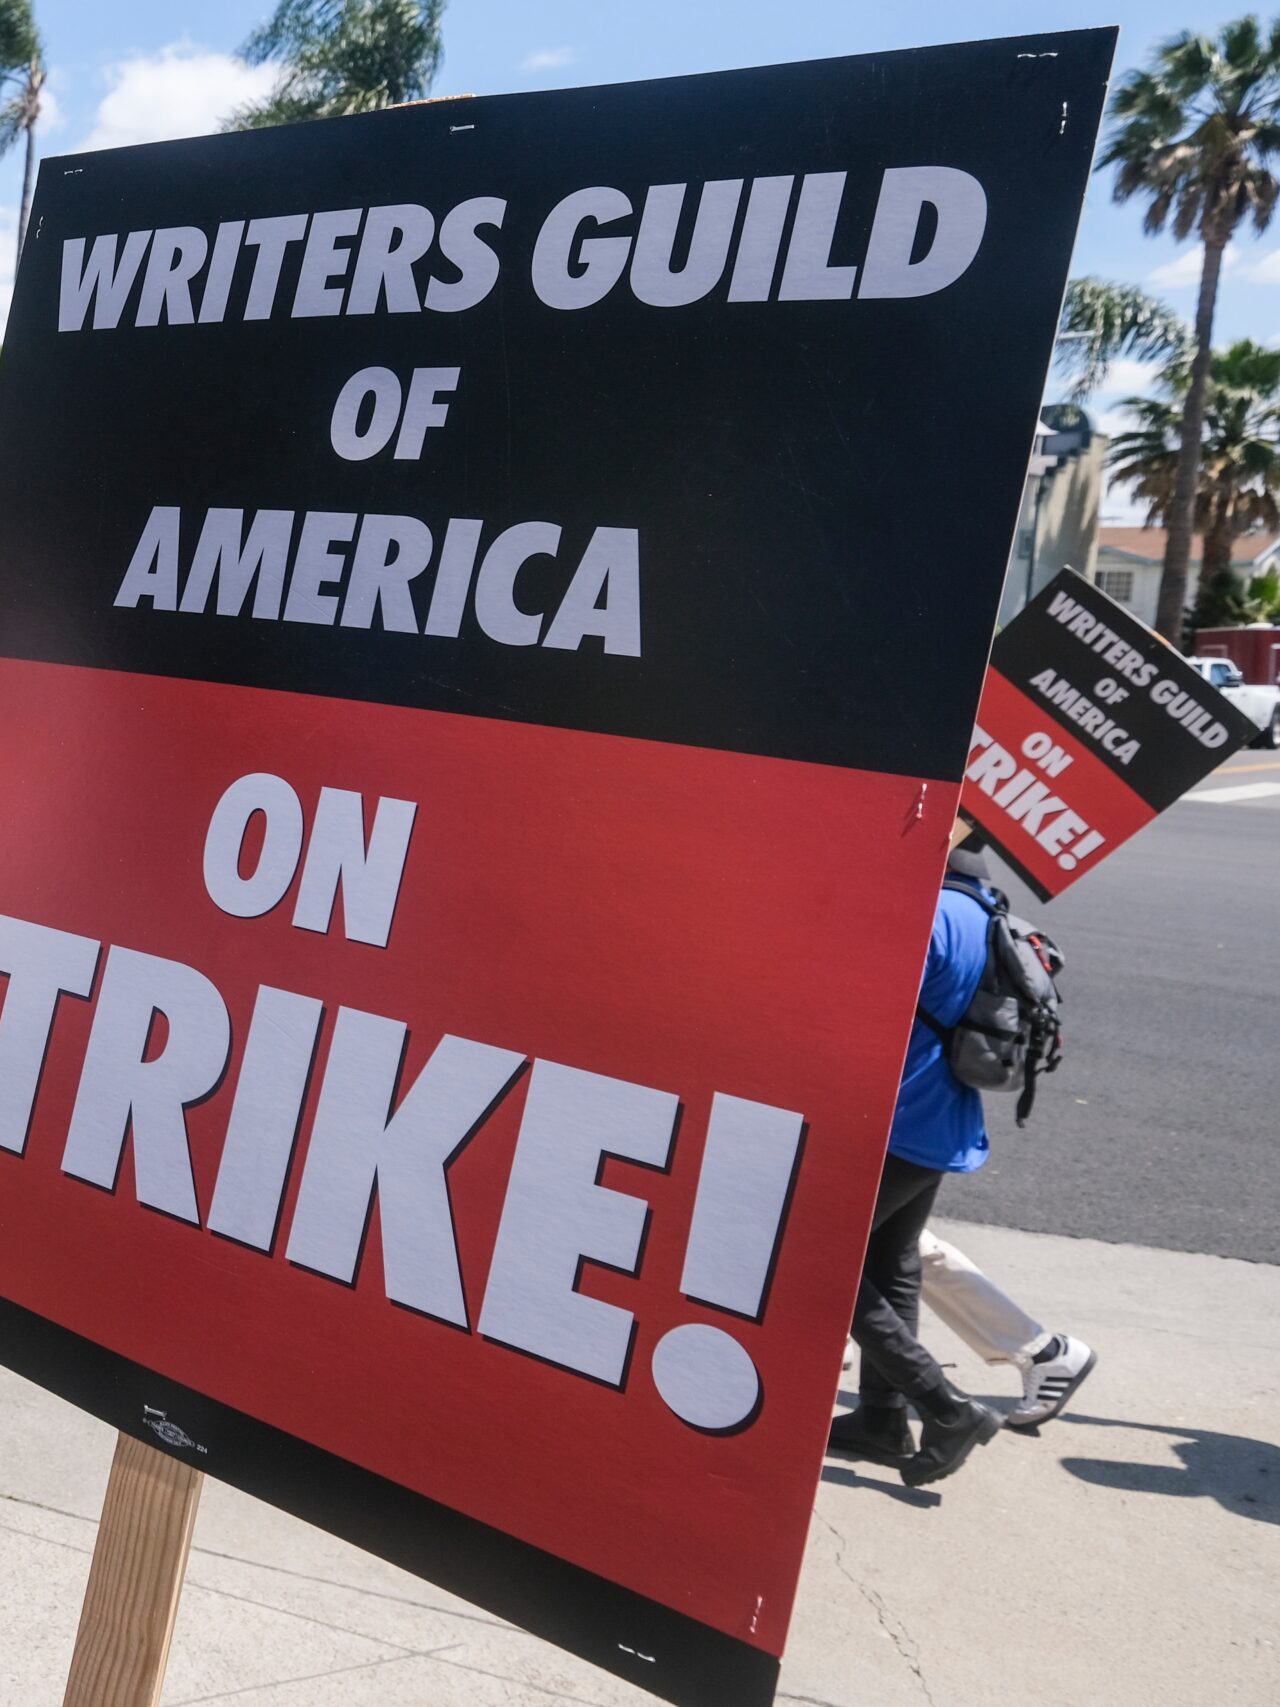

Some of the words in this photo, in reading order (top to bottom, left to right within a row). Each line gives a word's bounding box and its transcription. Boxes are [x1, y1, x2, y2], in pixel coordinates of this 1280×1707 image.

[58, 196, 507, 332] WRITERS
[531, 166, 987, 309] GUILD
[330, 366, 460, 461] OF
[114, 506, 640, 657] AMERICA
[1029, 669, 1141, 765] AMERICA
[1046, 590, 1159, 687] WRITERS
[1149, 680, 1229, 749] GUILD
[1094, 678, 1129, 704] OF
[964, 723, 1106, 870] TRIKE!
[1021, 732, 1074, 778] ON
[202, 773, 417, 948] ON
